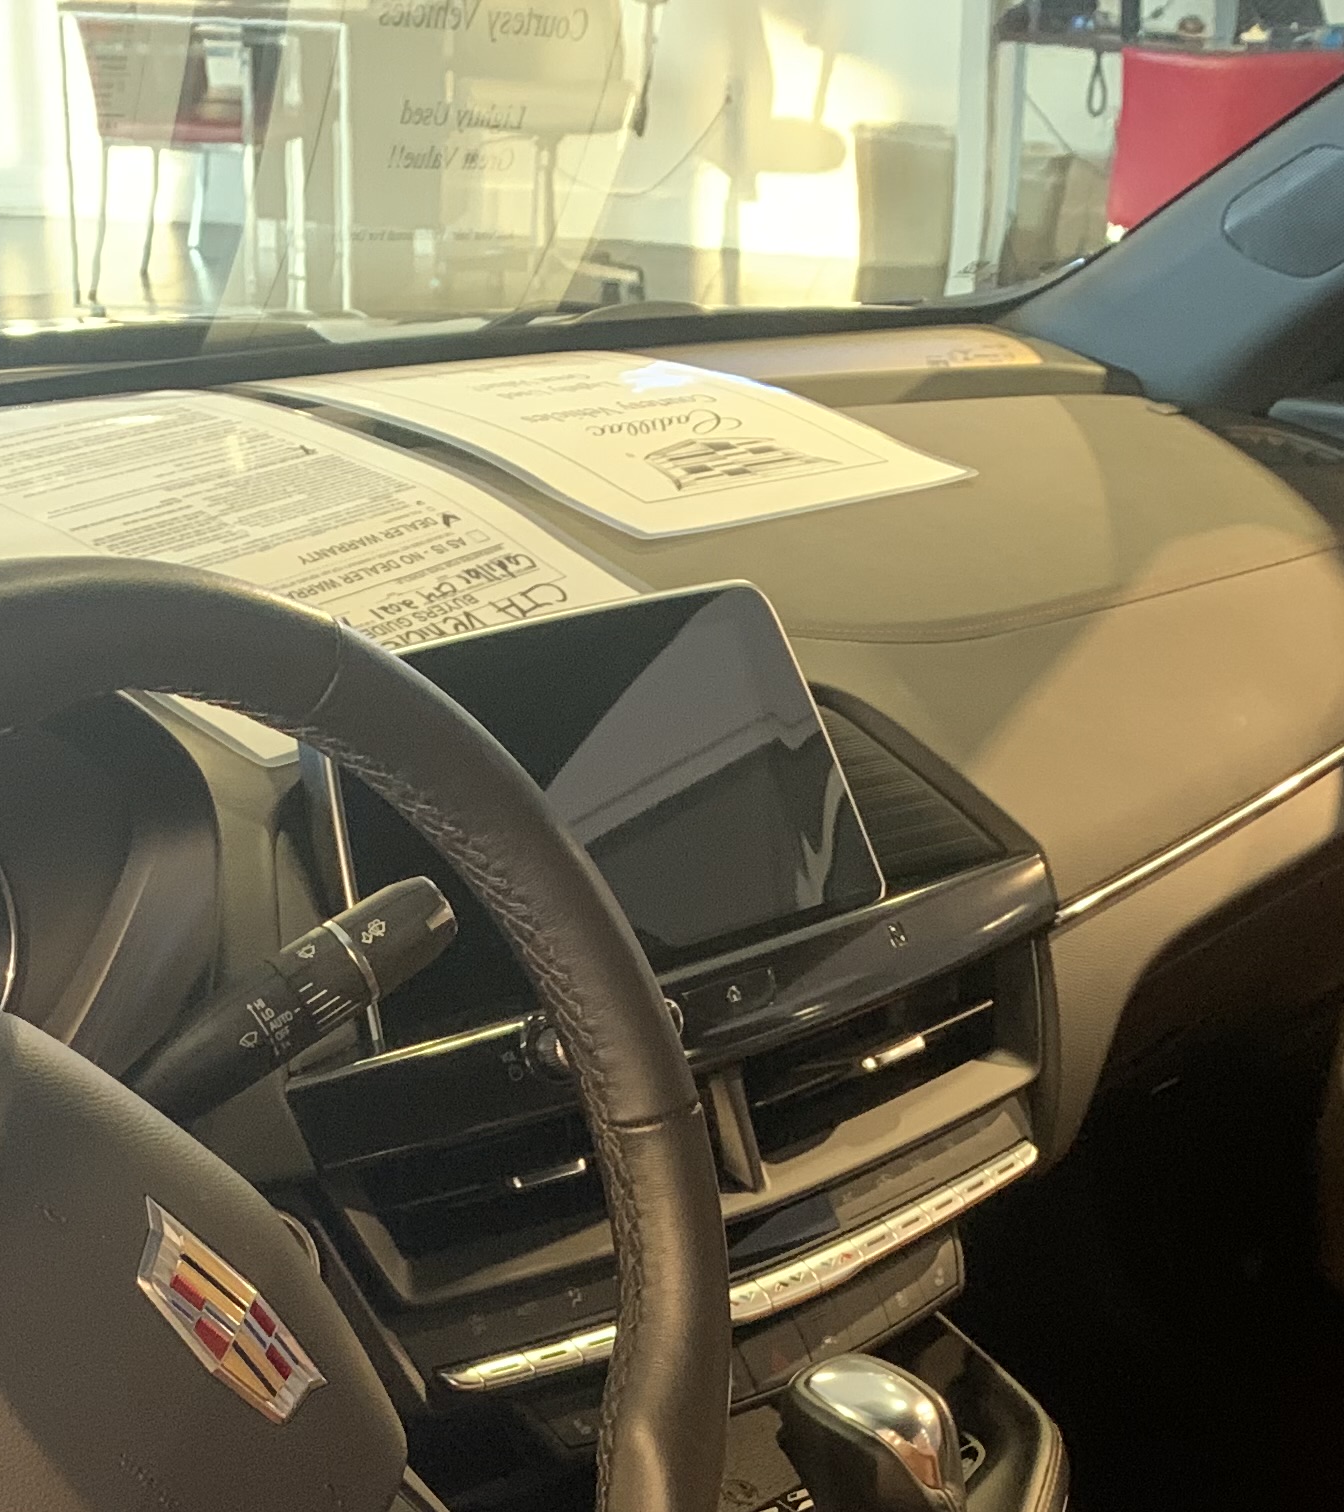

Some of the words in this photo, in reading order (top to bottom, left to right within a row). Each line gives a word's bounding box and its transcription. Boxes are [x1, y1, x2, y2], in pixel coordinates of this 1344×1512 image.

[585, 408, 742, 436] Cadillac
[379, 516, 438, 540] DEALER
[298, 534, 383, 565] WARRANTY
[430, 543, 449, 555] IS
[446, 536, 467, 549] AS
[399, 551, 426, 565] NO
[338, 559, 402, 585] DEALER
[285, 578, 343, 600] WARRA
[412, 593, 480, 623] BUYERS
[358, 616, 414, 640] GUIDE
[260, 1007, 276, 1022] LO
[269, 1010, 294, 1033] AUTO
